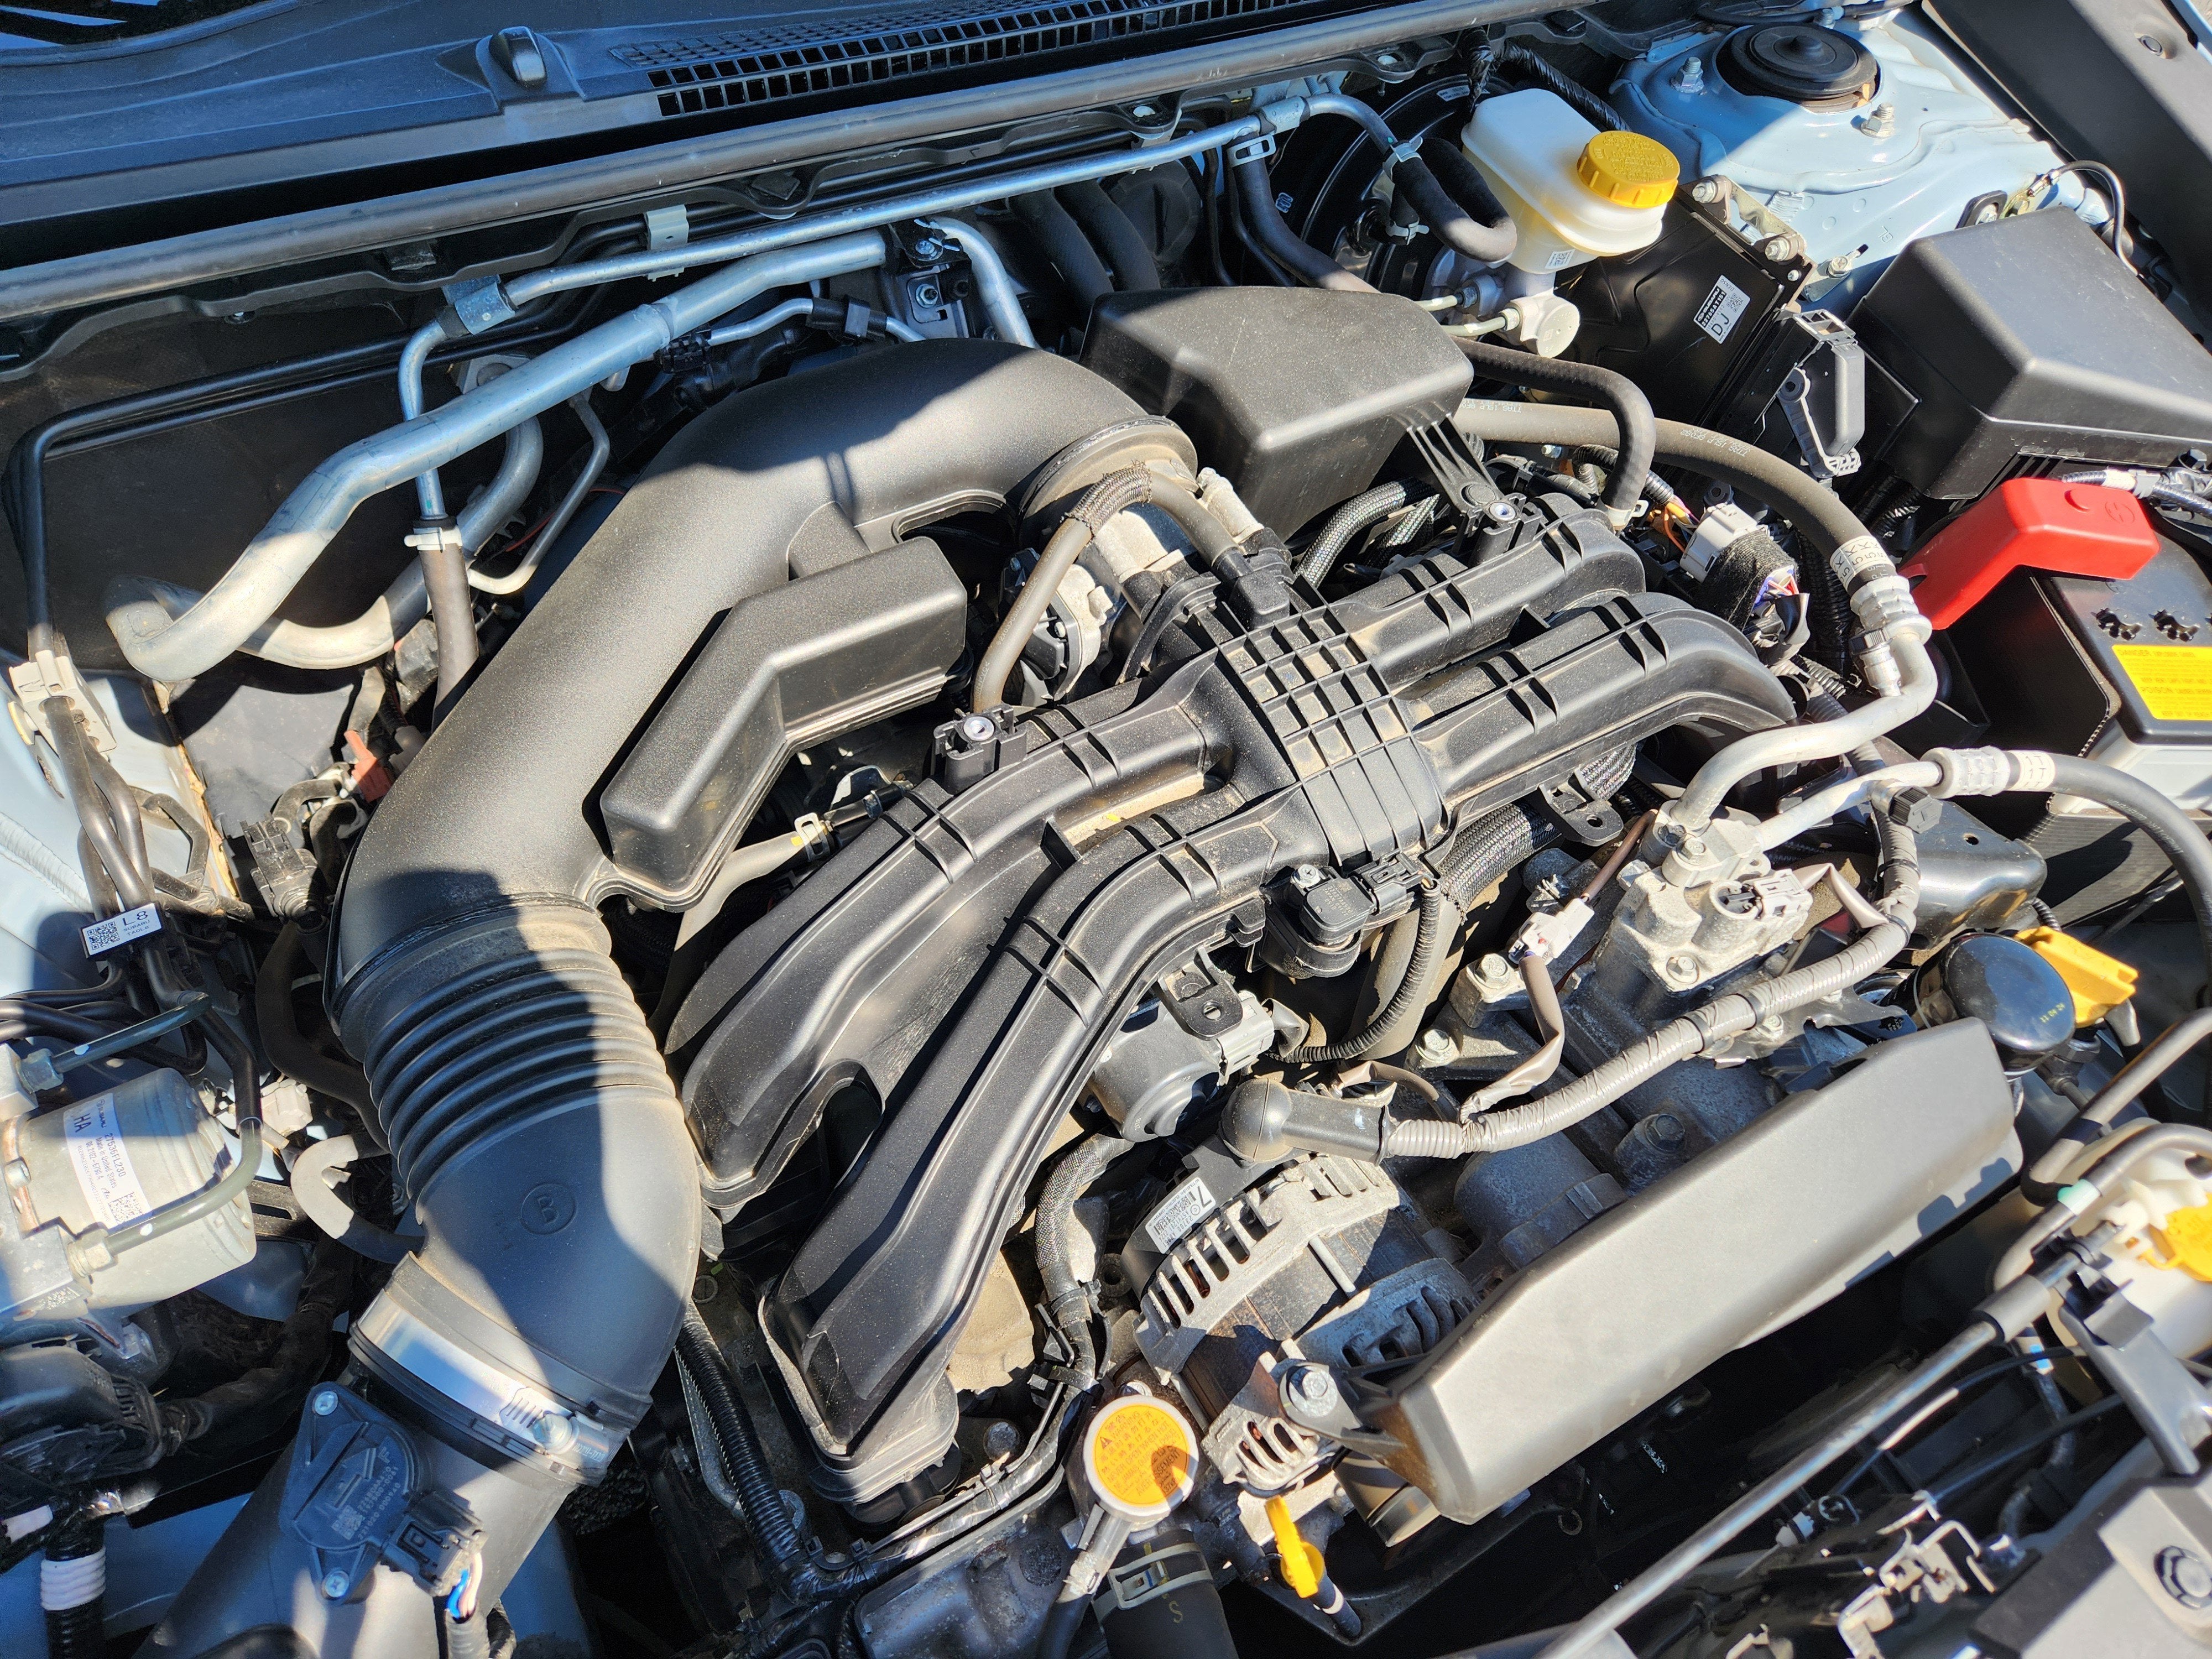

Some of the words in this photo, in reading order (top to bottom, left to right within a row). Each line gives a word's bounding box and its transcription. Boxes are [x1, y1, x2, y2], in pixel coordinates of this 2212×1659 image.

[1720, 278, 1734, 291] DENSO
[1703, 288, 1720, 313] SUBARU
[1845, 545, 1863, 565] 5K
[1835, 556, 1850, 577] 5K
[122, 911, 148, 926] L8
[123, 920, 150, 932] SUBARU
[73, 1113, 92, 1133] HA
[98, 1107, 107, 1128] SUBARU
[95, 1138, 104, 1150] Made
[101, 1156, 112, 1171] United
[107, 1173, 118, 1188] States
[104, 1133, 126, 1177] 27536FL230
[1197, 1186, 1212, 1209] 7
[537, 1194, 555, 1224] B
[1177, 1215, 1193, 1231] 23700
[1110, 1410, 1139, 1439] WARNING
[377, 1446, 390, 1464] F
[1107, 1463, 1126, 1481] NEVER
[1125, 1449, 1141, 1465] OPEN
[1141, 1432, 1158, 1450] WHEN
[1157, 1421, 1168, 1433] HOT
[1135, 1451, 1180, 1495] AVERTISSEMENT
[1168, 1600, 1184, 1624] S
